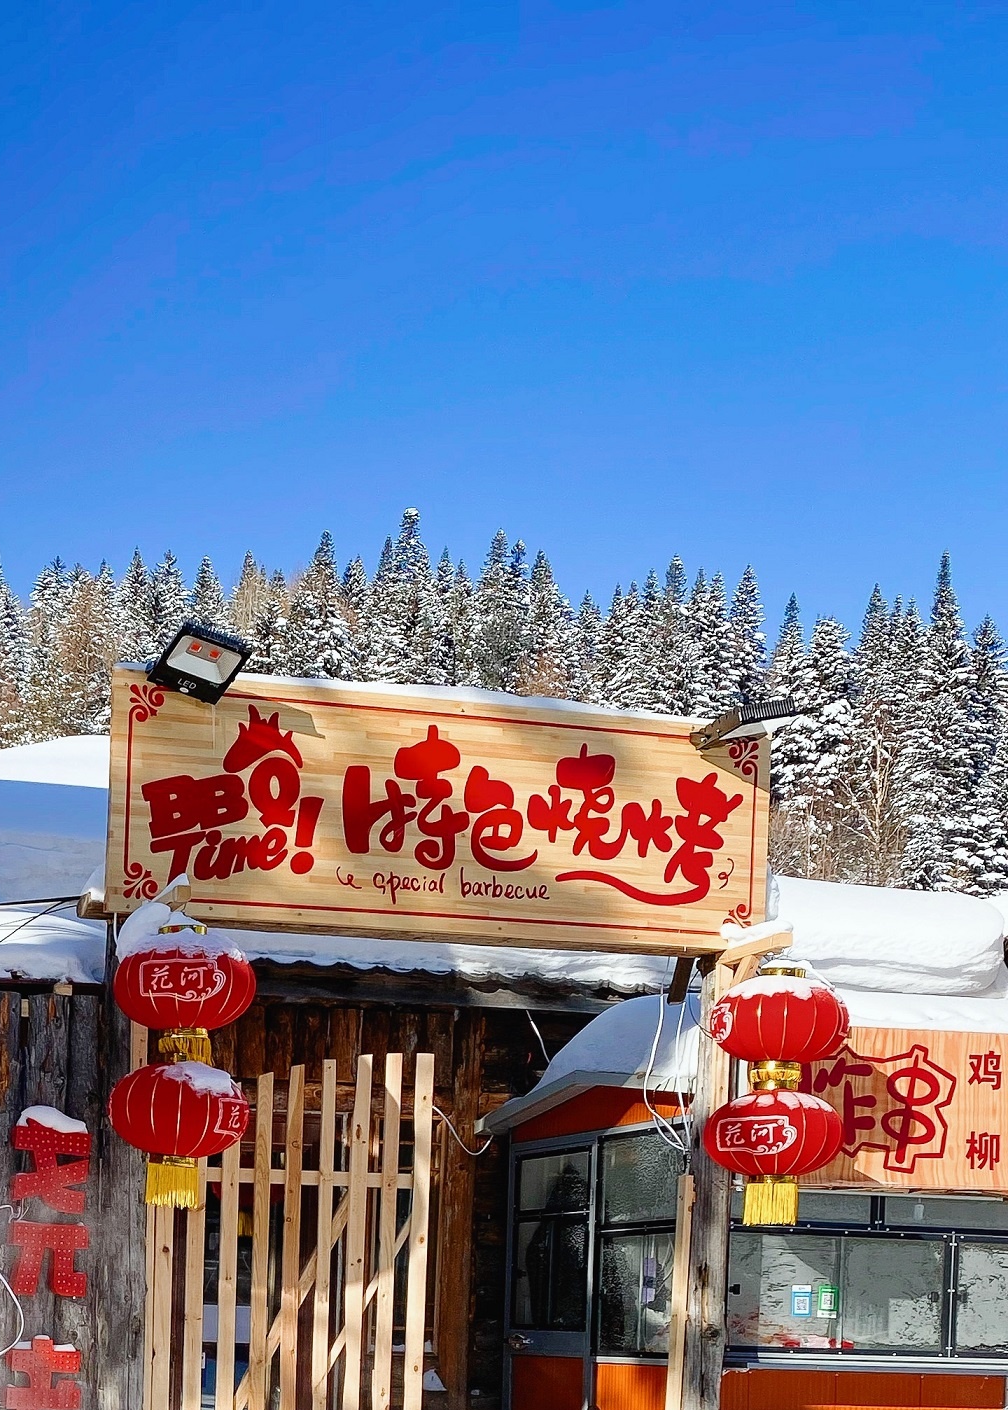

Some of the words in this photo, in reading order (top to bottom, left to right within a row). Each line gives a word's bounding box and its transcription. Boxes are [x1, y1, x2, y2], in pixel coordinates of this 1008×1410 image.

[177, 678, 197, 690] LED
[342, 725, 743, 905] 特色烧烤
[460, 867, 550, 900] barbecue
[150, 964, 205, 991] 花河
[724, 1122, 775, 1146] 花河
